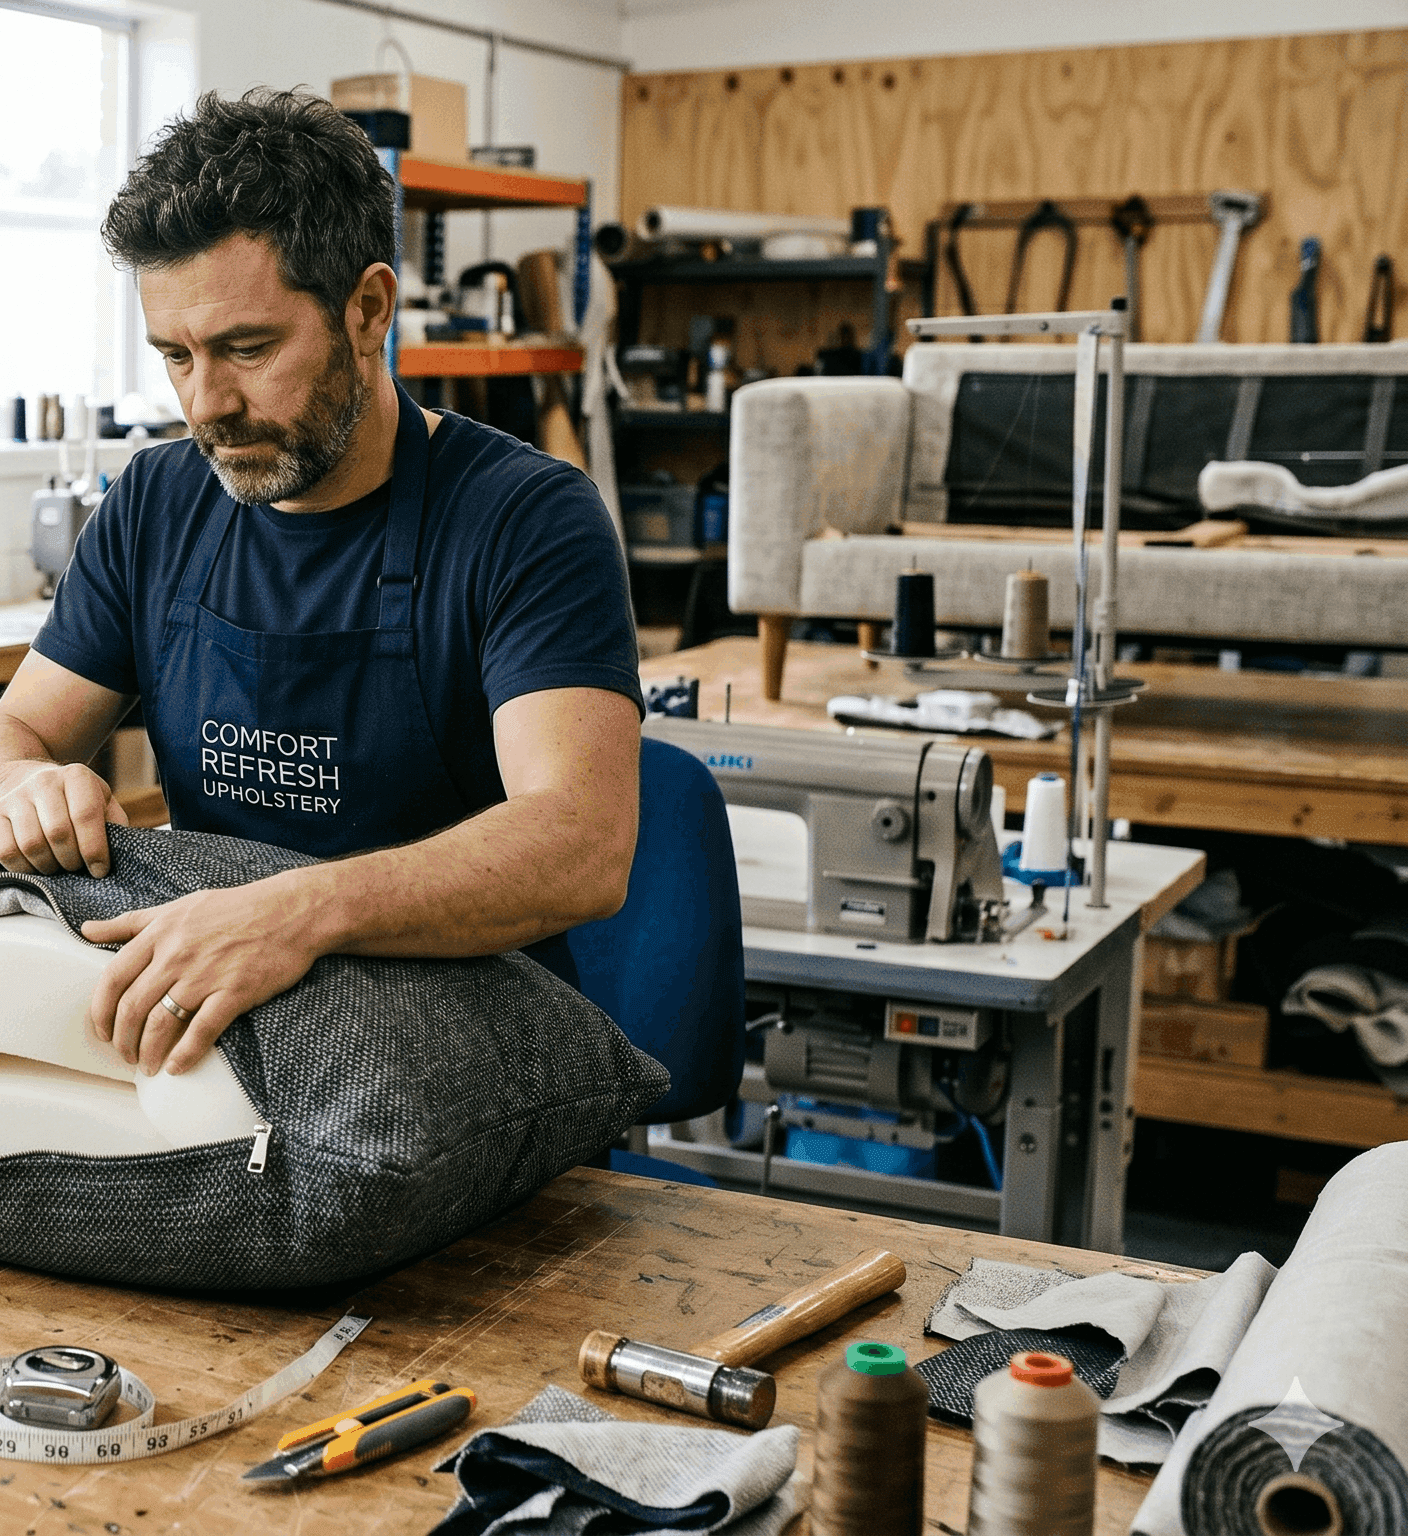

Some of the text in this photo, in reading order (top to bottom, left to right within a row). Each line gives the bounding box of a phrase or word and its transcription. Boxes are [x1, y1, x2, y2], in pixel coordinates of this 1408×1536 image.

[201, 719, 338, 760] COMFORT
[201, 747, 340, 791] REFRESH
[202, 778, 341, 815] UPHOLSTERY
[147, 1434, 169, 1451] 93
